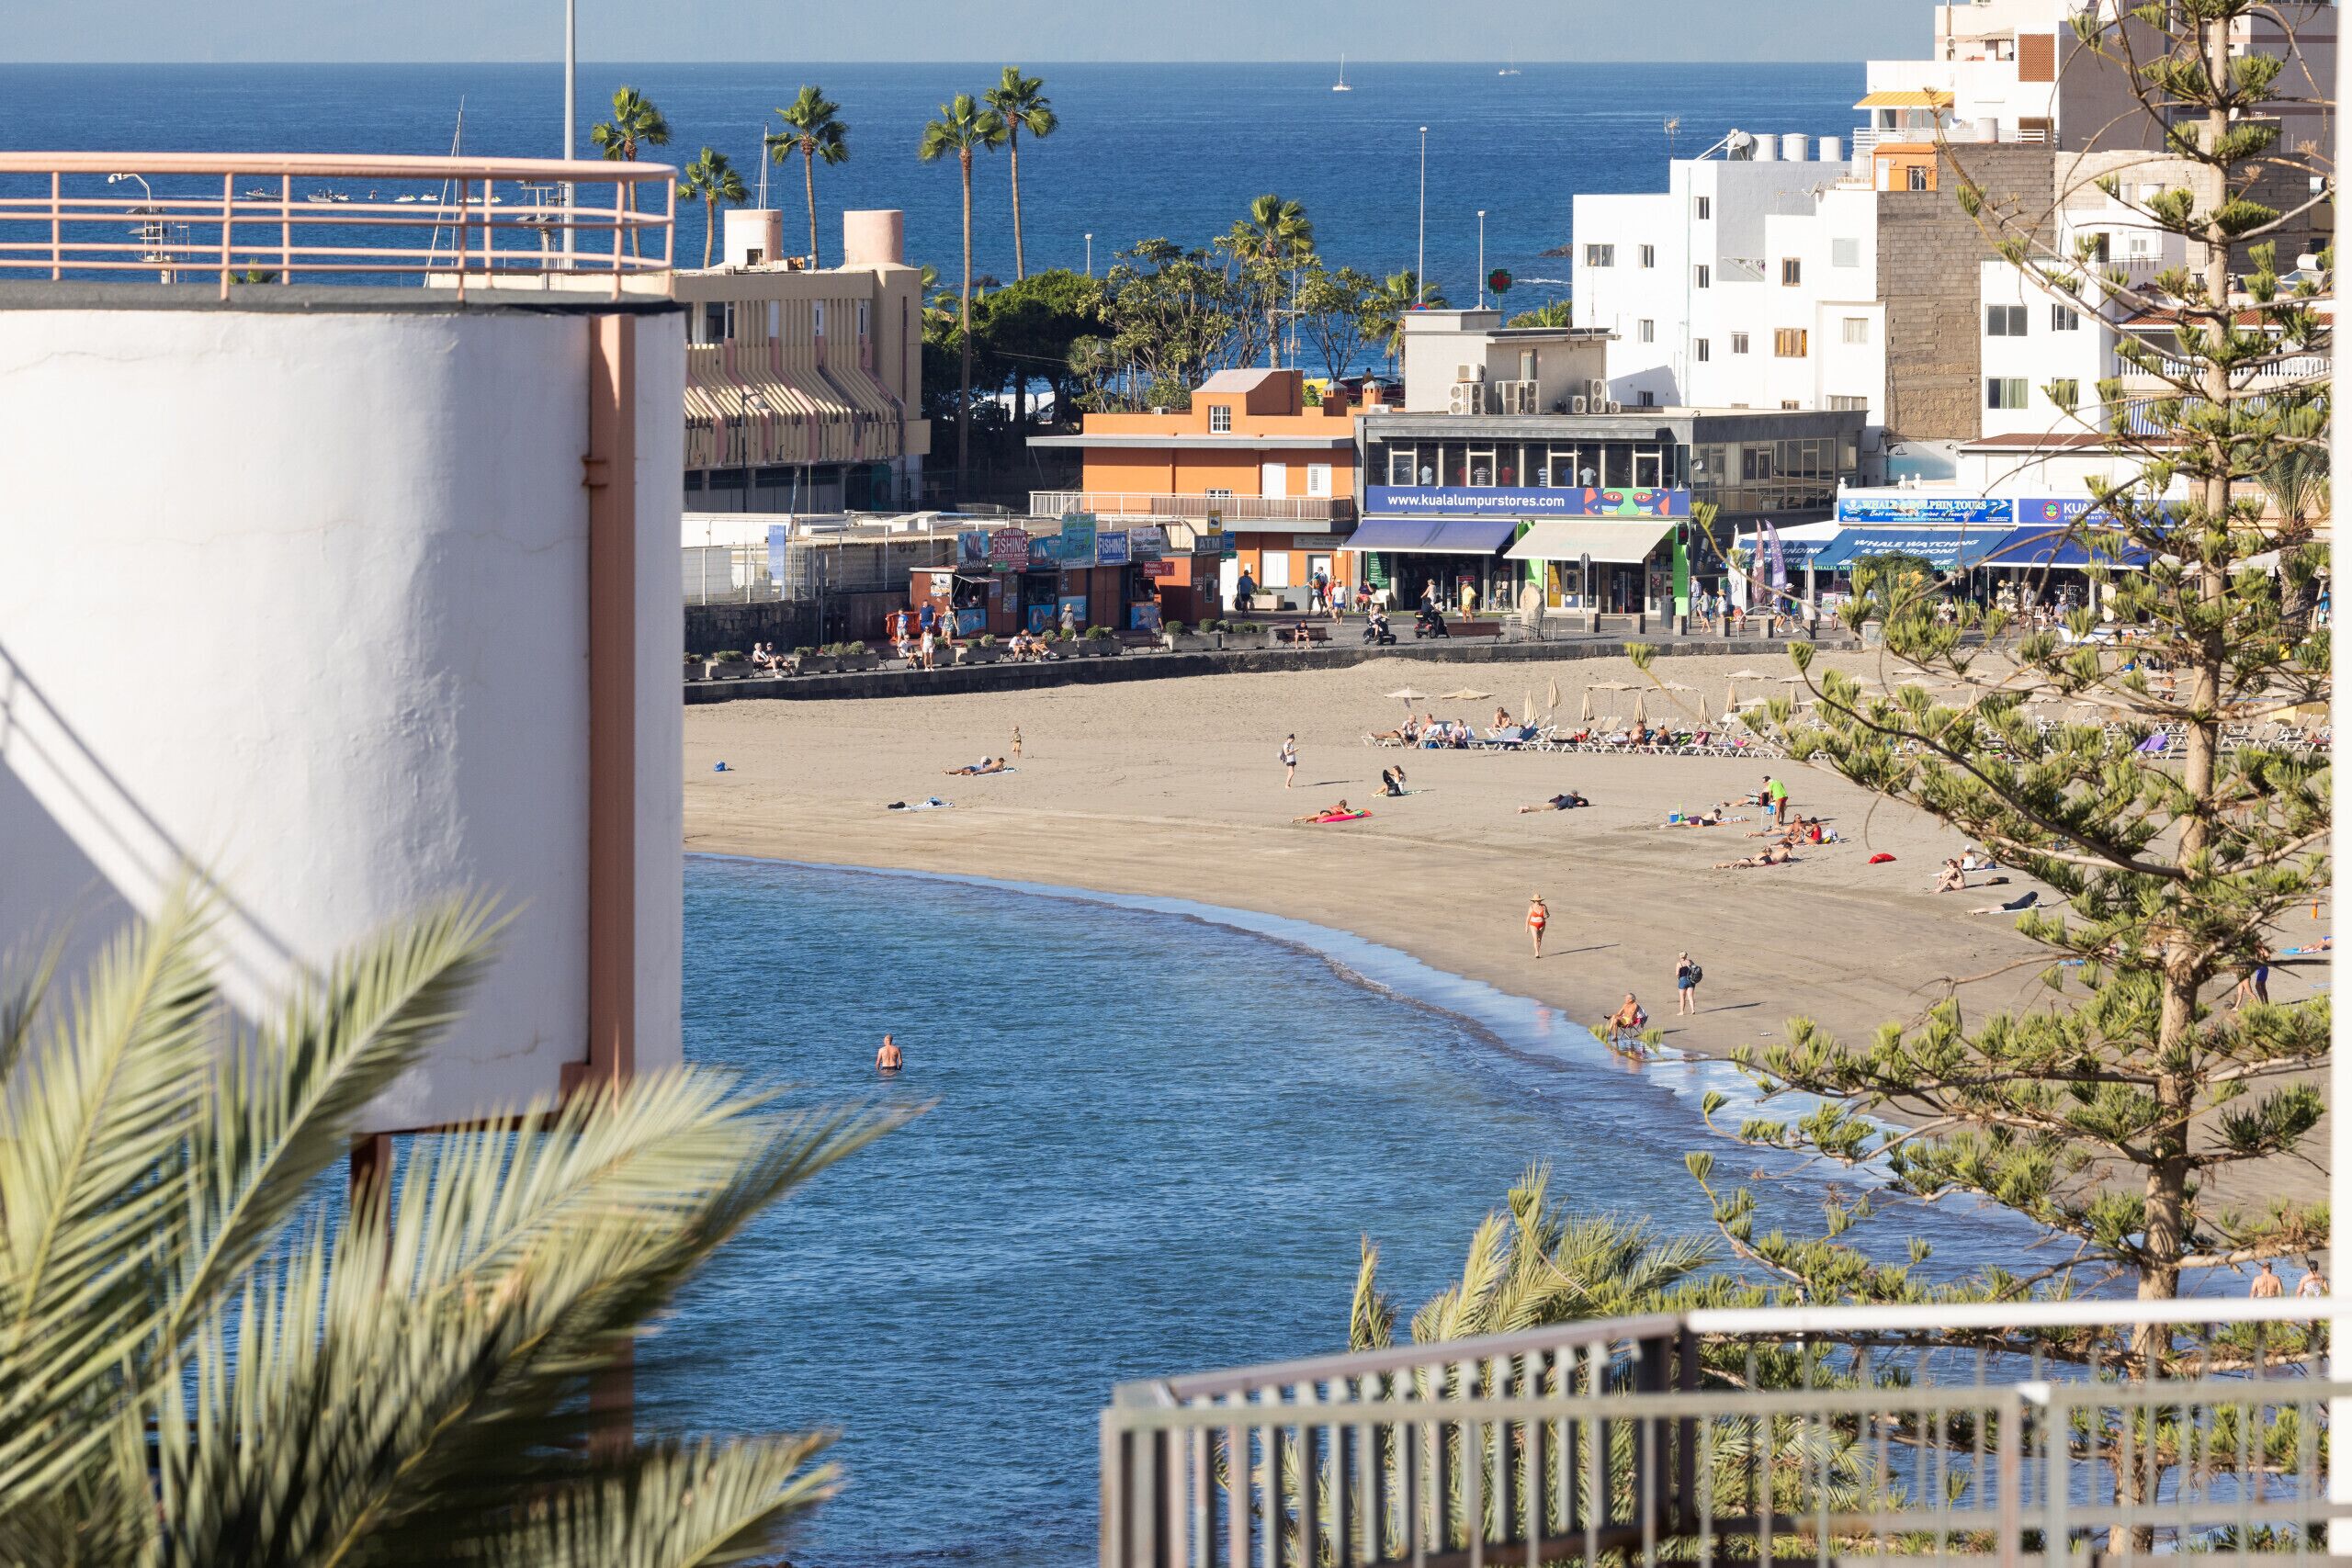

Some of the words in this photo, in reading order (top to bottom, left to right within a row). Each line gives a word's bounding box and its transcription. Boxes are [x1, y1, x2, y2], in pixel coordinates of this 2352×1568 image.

[1387, 494, 1565, 508] www.kualalumpurstores.com
[1861, 500, 1897, 510] WHALE
[1909, 500, 1954, 510] DOLPHIN
[1955, 500, 1987, 510] TOURS
[993, 536, 1027, 554] FISHING
[1098, 537, 1126, 555] FISHING
[1198, 537, 1220, 549] ATM
[1854, 539, 1904, 547] WHALE
[1905, 539, 1980, 548] WATCHING
